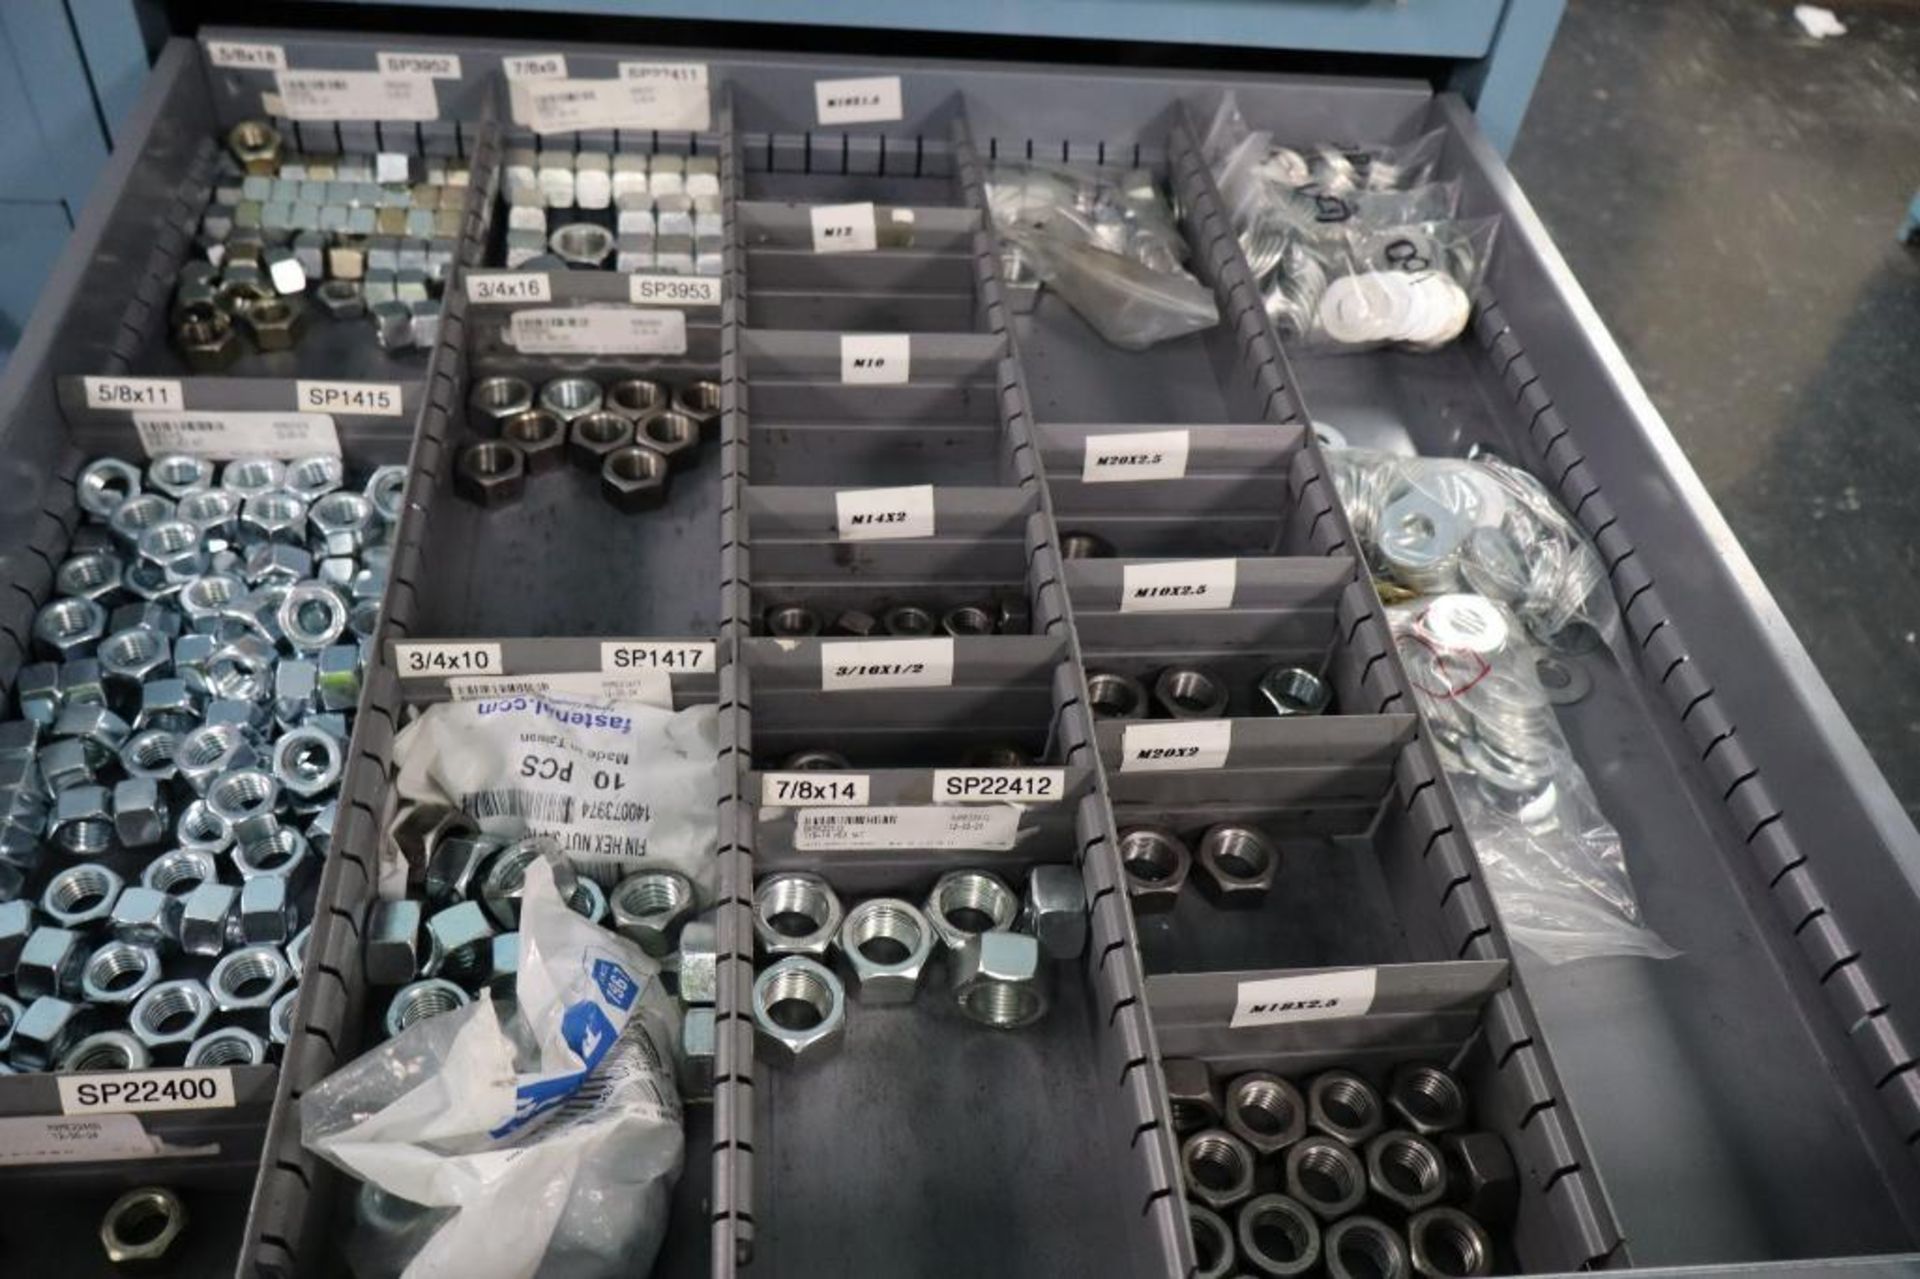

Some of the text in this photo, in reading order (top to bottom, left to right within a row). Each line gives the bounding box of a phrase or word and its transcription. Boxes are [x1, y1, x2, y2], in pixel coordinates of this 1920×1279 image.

[478, 280, 540, 298] 3/4x16
[641, 281, 711, 300] SP3953
[853, 357, 885, 368] M10
[98, 385, 168, 404] 5/8x11
[310, 388, 391, 408] SP1415
[410, 650, 489, 671] 3/4x10
[614, 648, 703, 668] SP1417
[519, 755, 626, 791] 10 PCS
[777, 781, 856, 801] 7/8x14
[946, 777, 1052, 796] SP22412
[565, 832, 592, 852] NUT
[595, 834, 623, 855] HEX
[625, 837, 647, 857] FIN
[77, 1078, 218, 1106] SP22400
